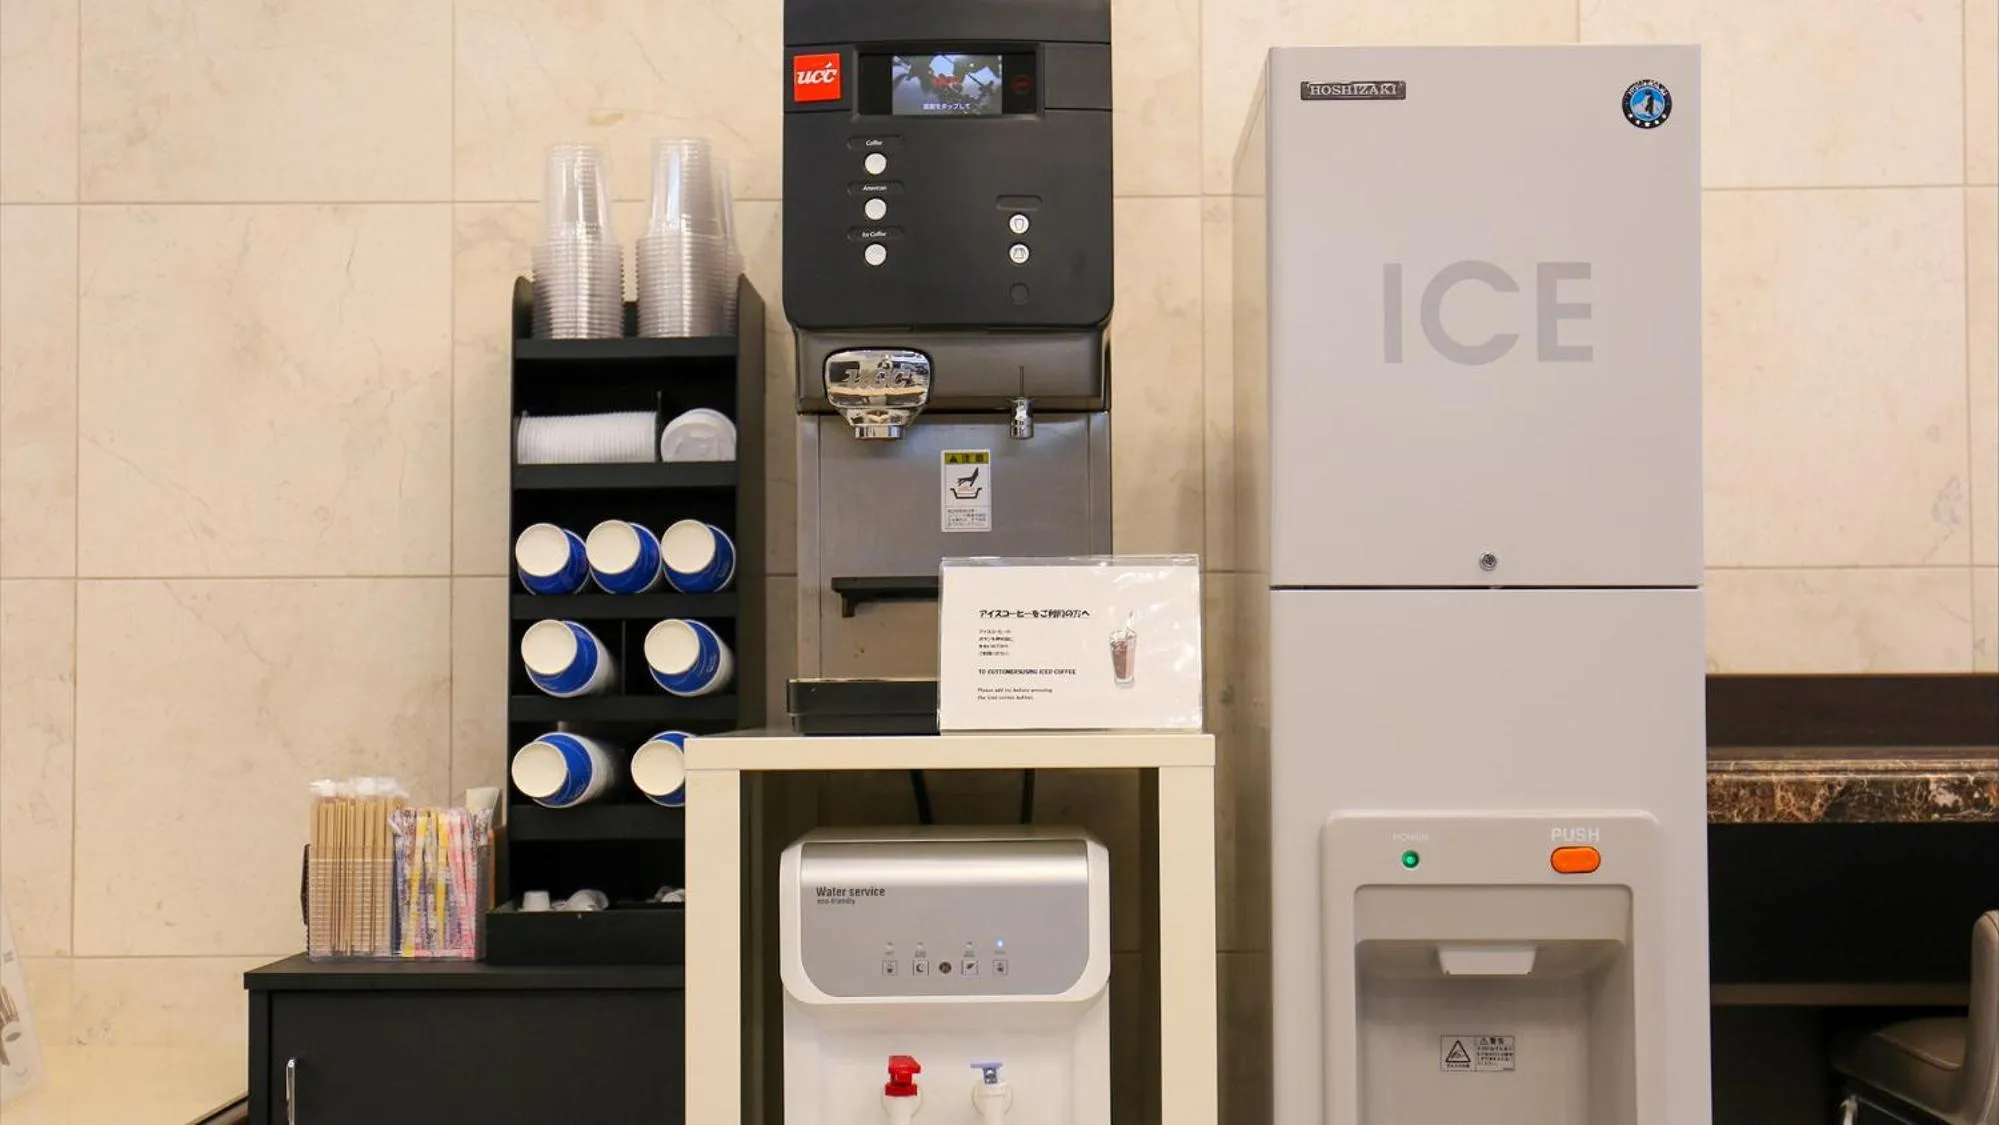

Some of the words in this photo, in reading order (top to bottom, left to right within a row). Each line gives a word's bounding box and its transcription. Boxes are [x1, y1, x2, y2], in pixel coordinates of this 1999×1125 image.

[1309, 84, 1398, 96] HOSHIZAKI
[1383, 260, 1594, 366] ICE
[979, 609, 1090, 618] アイスコーヒーをご利用の方へ
[1551, 827, 1600, 842] PUSH
[816, 886, 846, 897] Water
[849, 886, 886, 897] service
